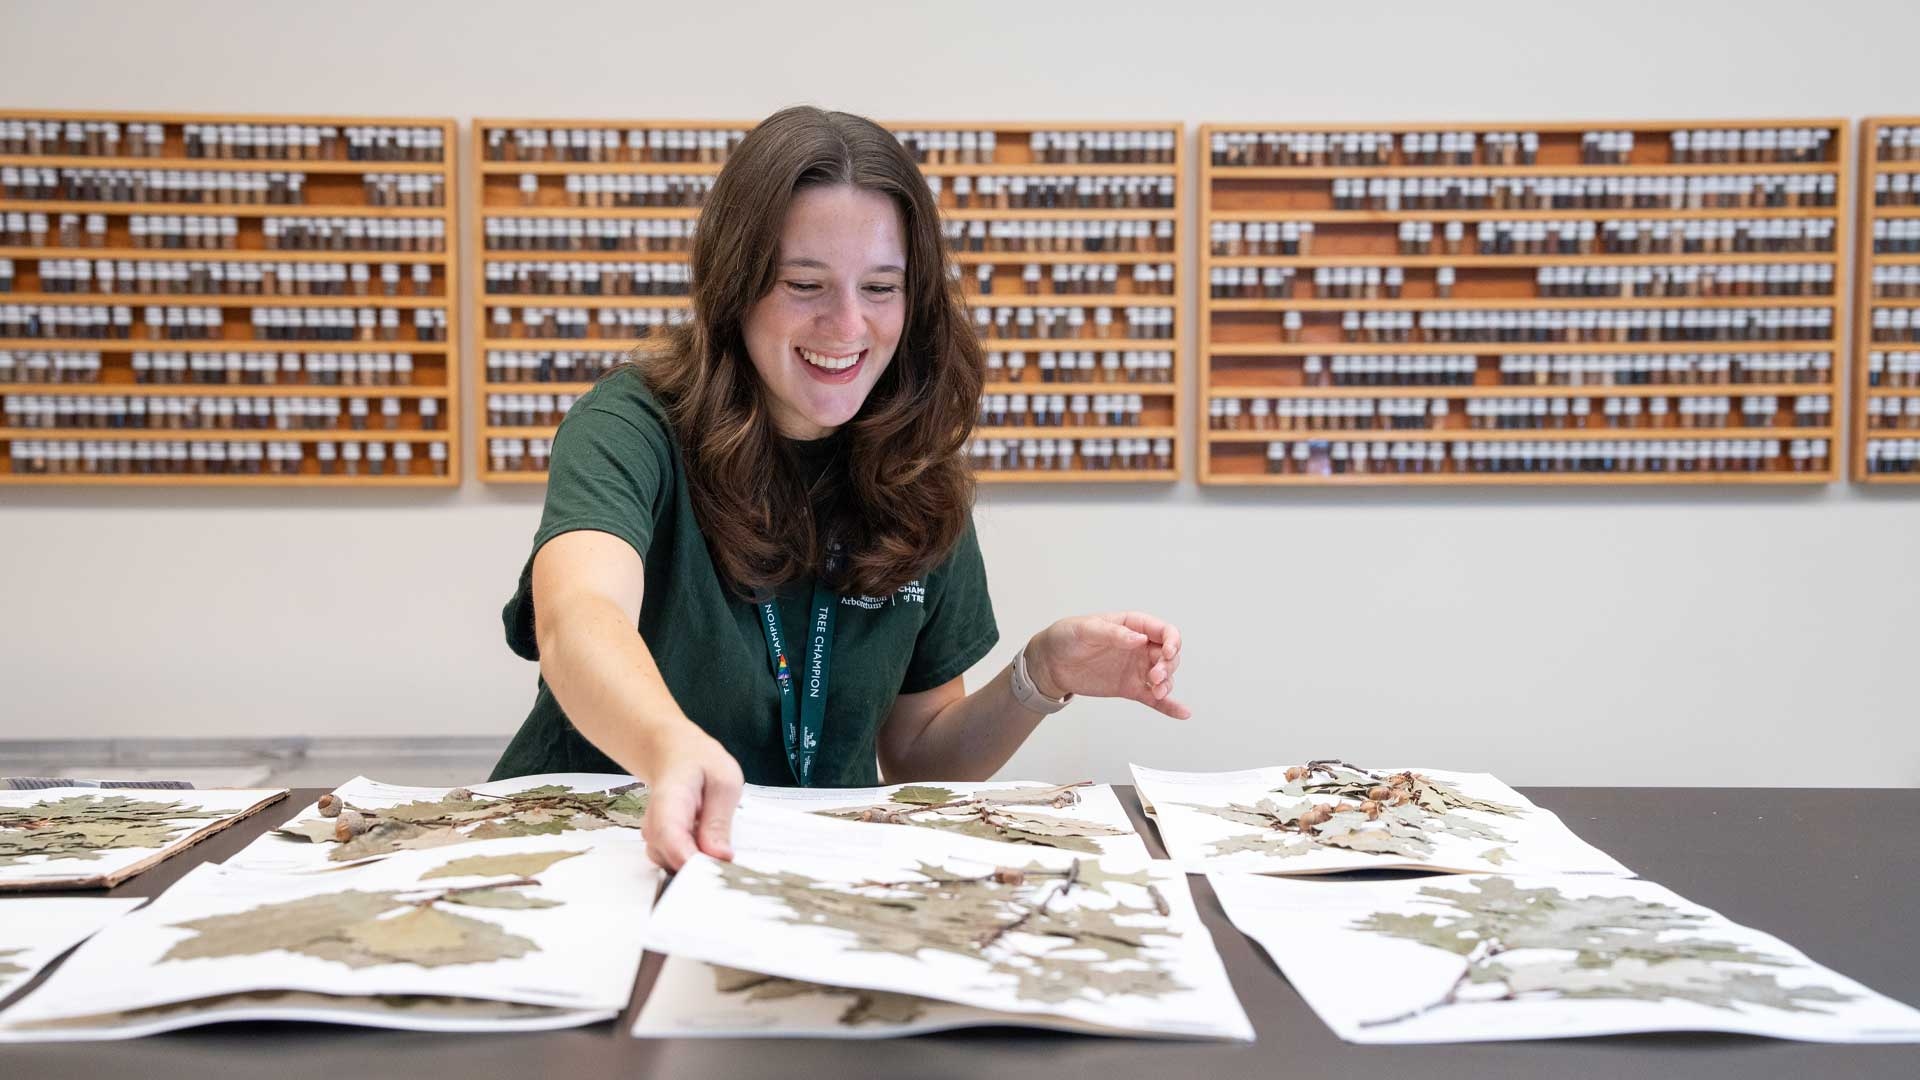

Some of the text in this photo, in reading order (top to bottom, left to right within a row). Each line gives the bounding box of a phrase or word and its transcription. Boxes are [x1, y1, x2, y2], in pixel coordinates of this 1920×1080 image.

[903, 593, 925, 603] of TRE
[764, 604, 782, 657] HAMPION
[810, 607, 829, 698] TREE CHAMPION
